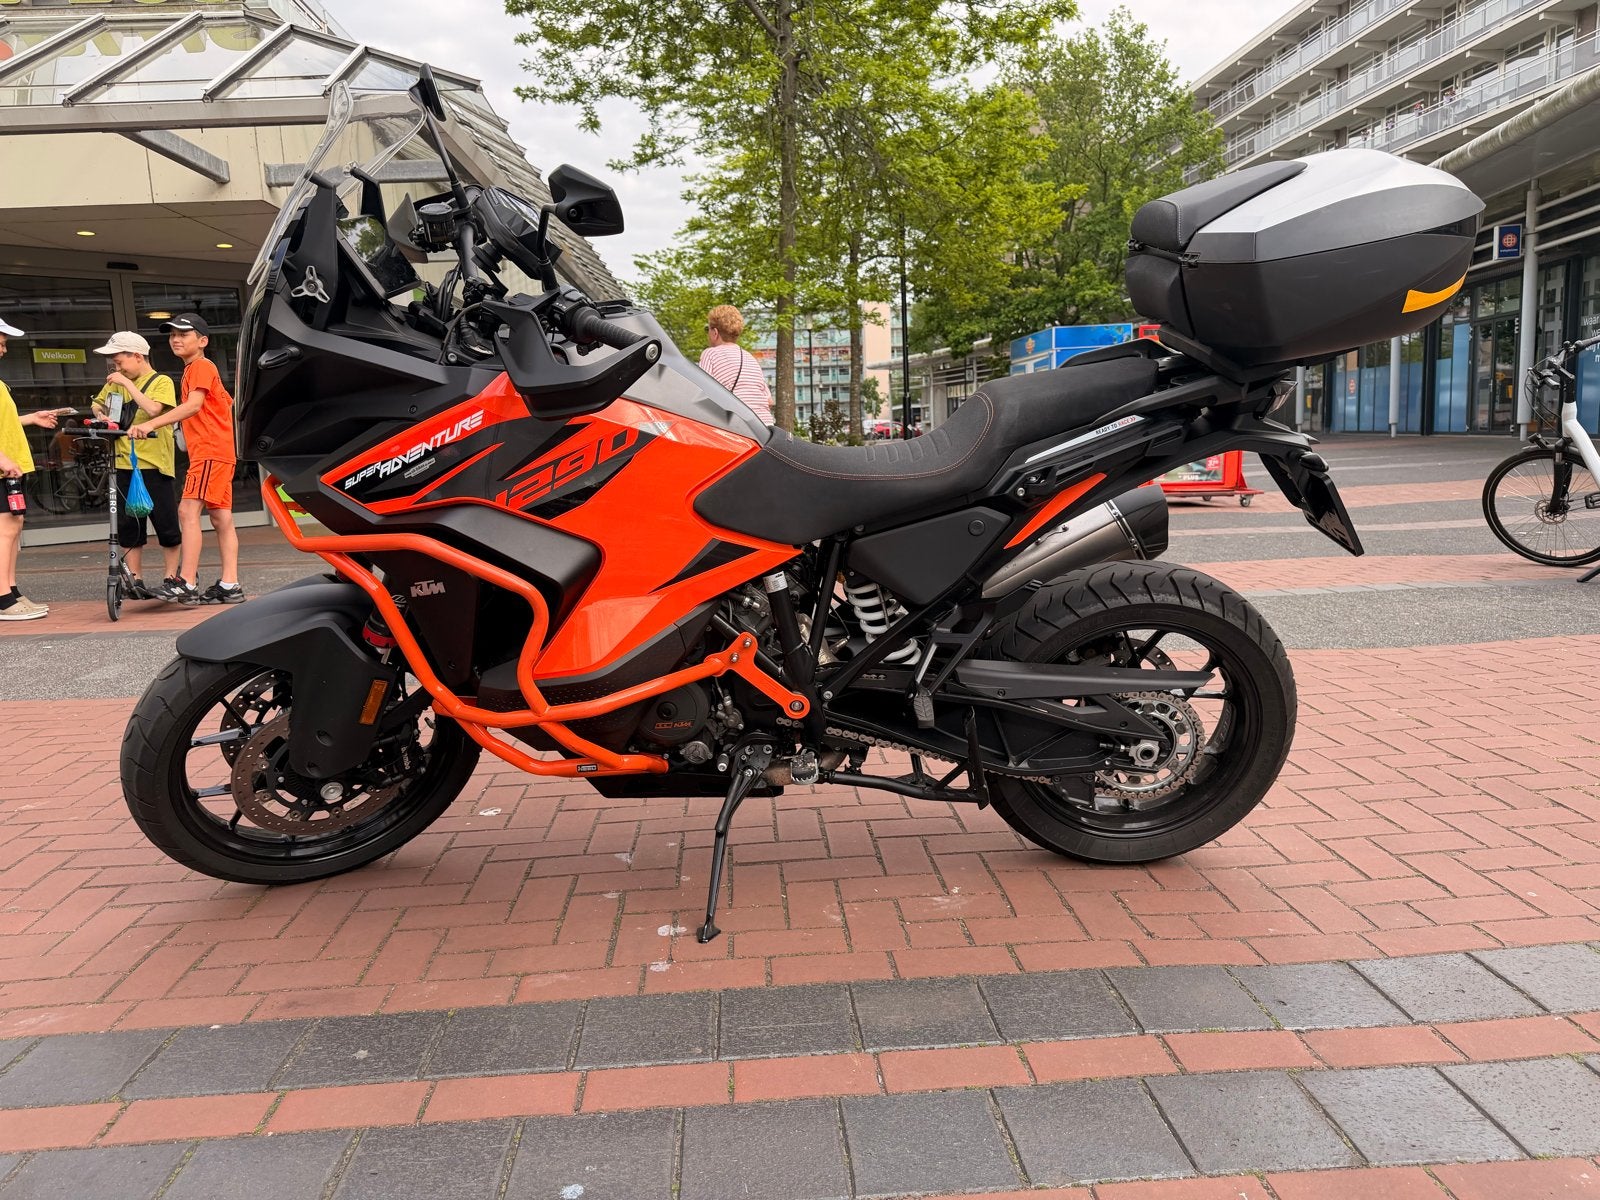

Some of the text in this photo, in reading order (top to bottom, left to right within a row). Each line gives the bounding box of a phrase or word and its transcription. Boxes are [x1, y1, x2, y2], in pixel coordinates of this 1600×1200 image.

[41, 351, 76, 360] Welkom
[1095, 426, 1111, 435] READY
[344, 461, 382, 490] SUPER
[379, 409, 484, 479] ADVENTURE
[495, 427, 640, 510] 1290
[410, 580, 446, 598] KTM
